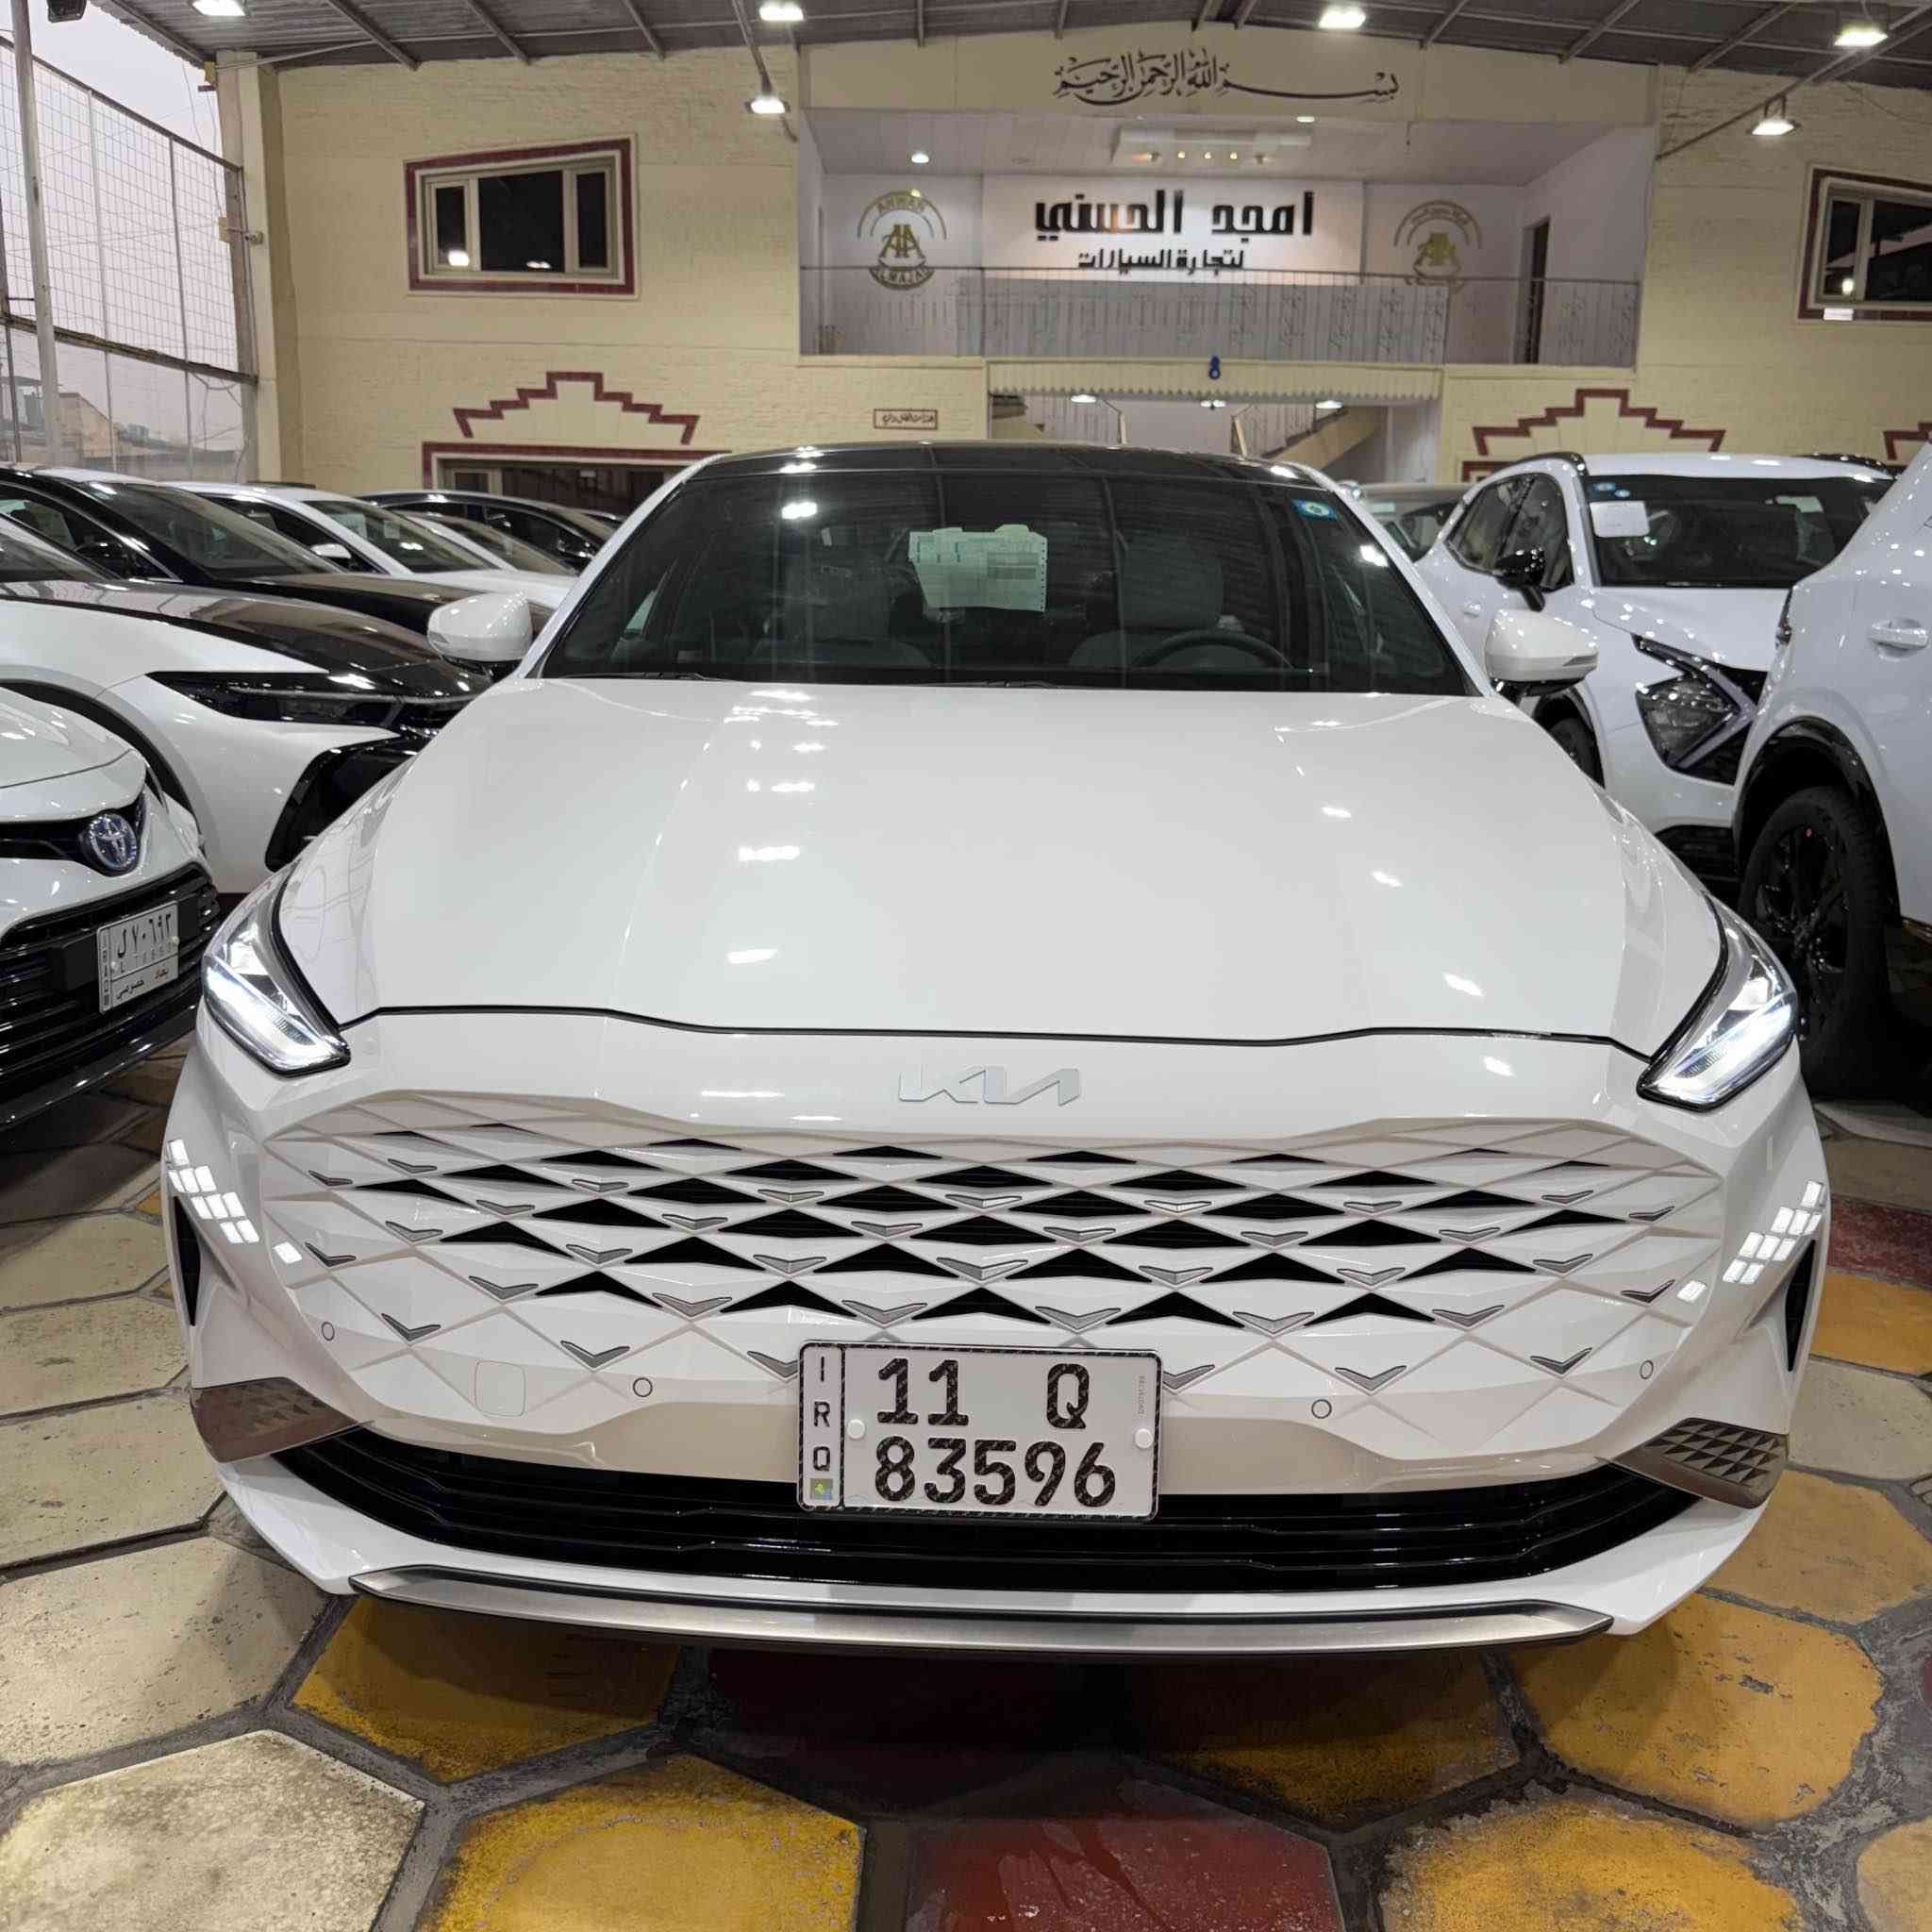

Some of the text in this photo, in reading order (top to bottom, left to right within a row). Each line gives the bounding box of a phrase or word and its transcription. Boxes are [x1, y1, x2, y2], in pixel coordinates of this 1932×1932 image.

[1211, 191, 1314, 243] امجد
[1077, 248, 1244, 276] لتجارة السيارات
[876, 1357, 970, 1426] 11
[1046, 1363, 1091, 1430] Q
[874, 1435, 1117, 1508] 83596
